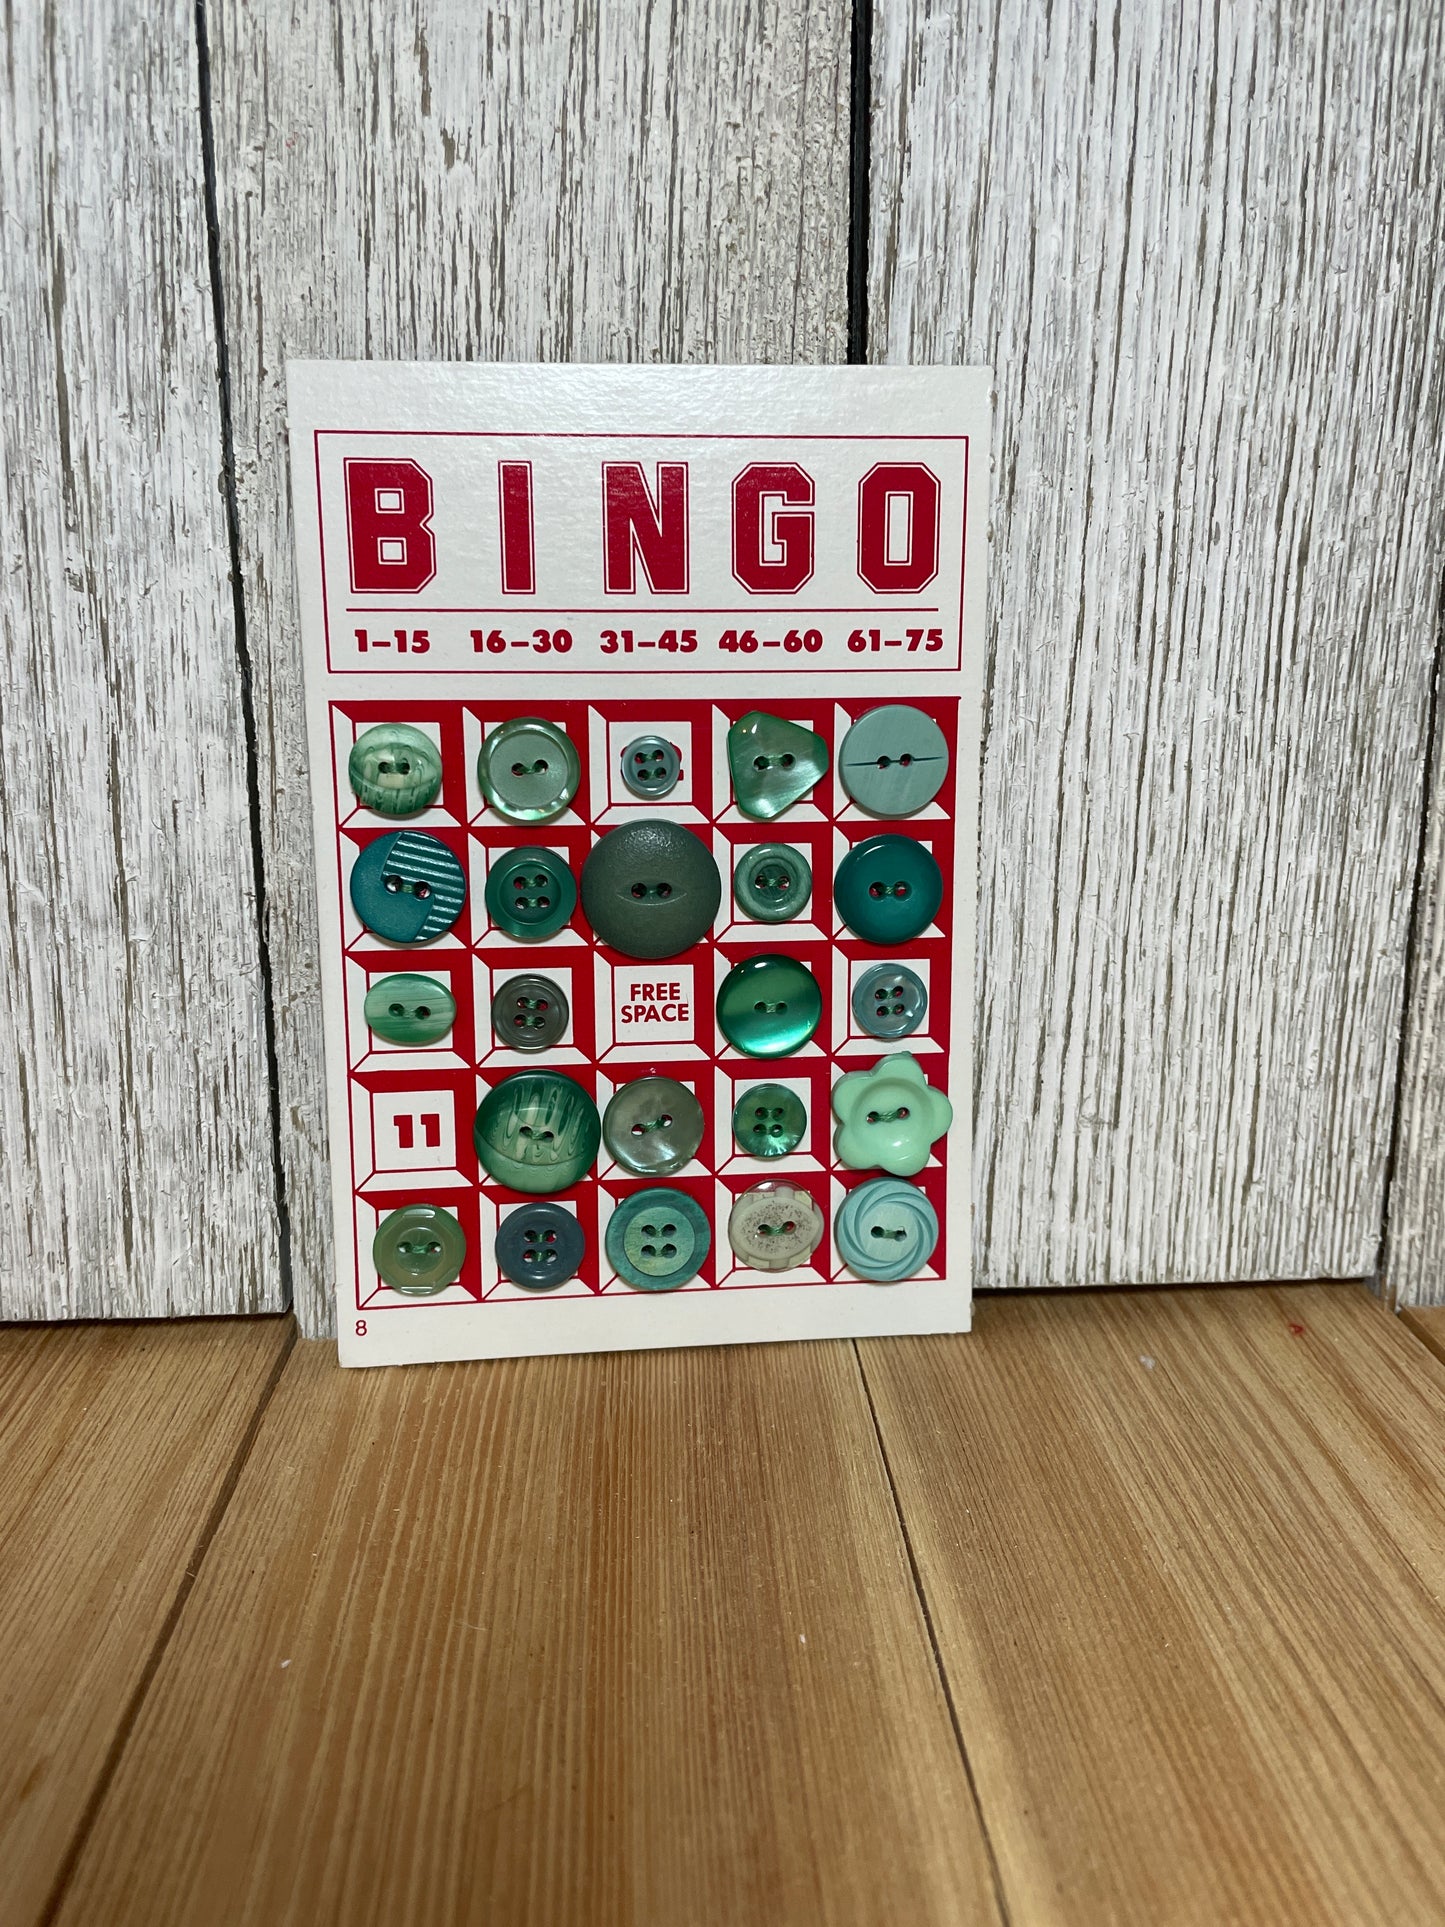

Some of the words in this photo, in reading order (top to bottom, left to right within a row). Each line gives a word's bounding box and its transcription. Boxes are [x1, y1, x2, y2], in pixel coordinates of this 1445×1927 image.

[629, 982, 681, 1003] FREE
[620, 1002, 689, 1024] SPACE
[392, 1112, 441, 1149] 11
[355, 1319, 368, 1337] 8
